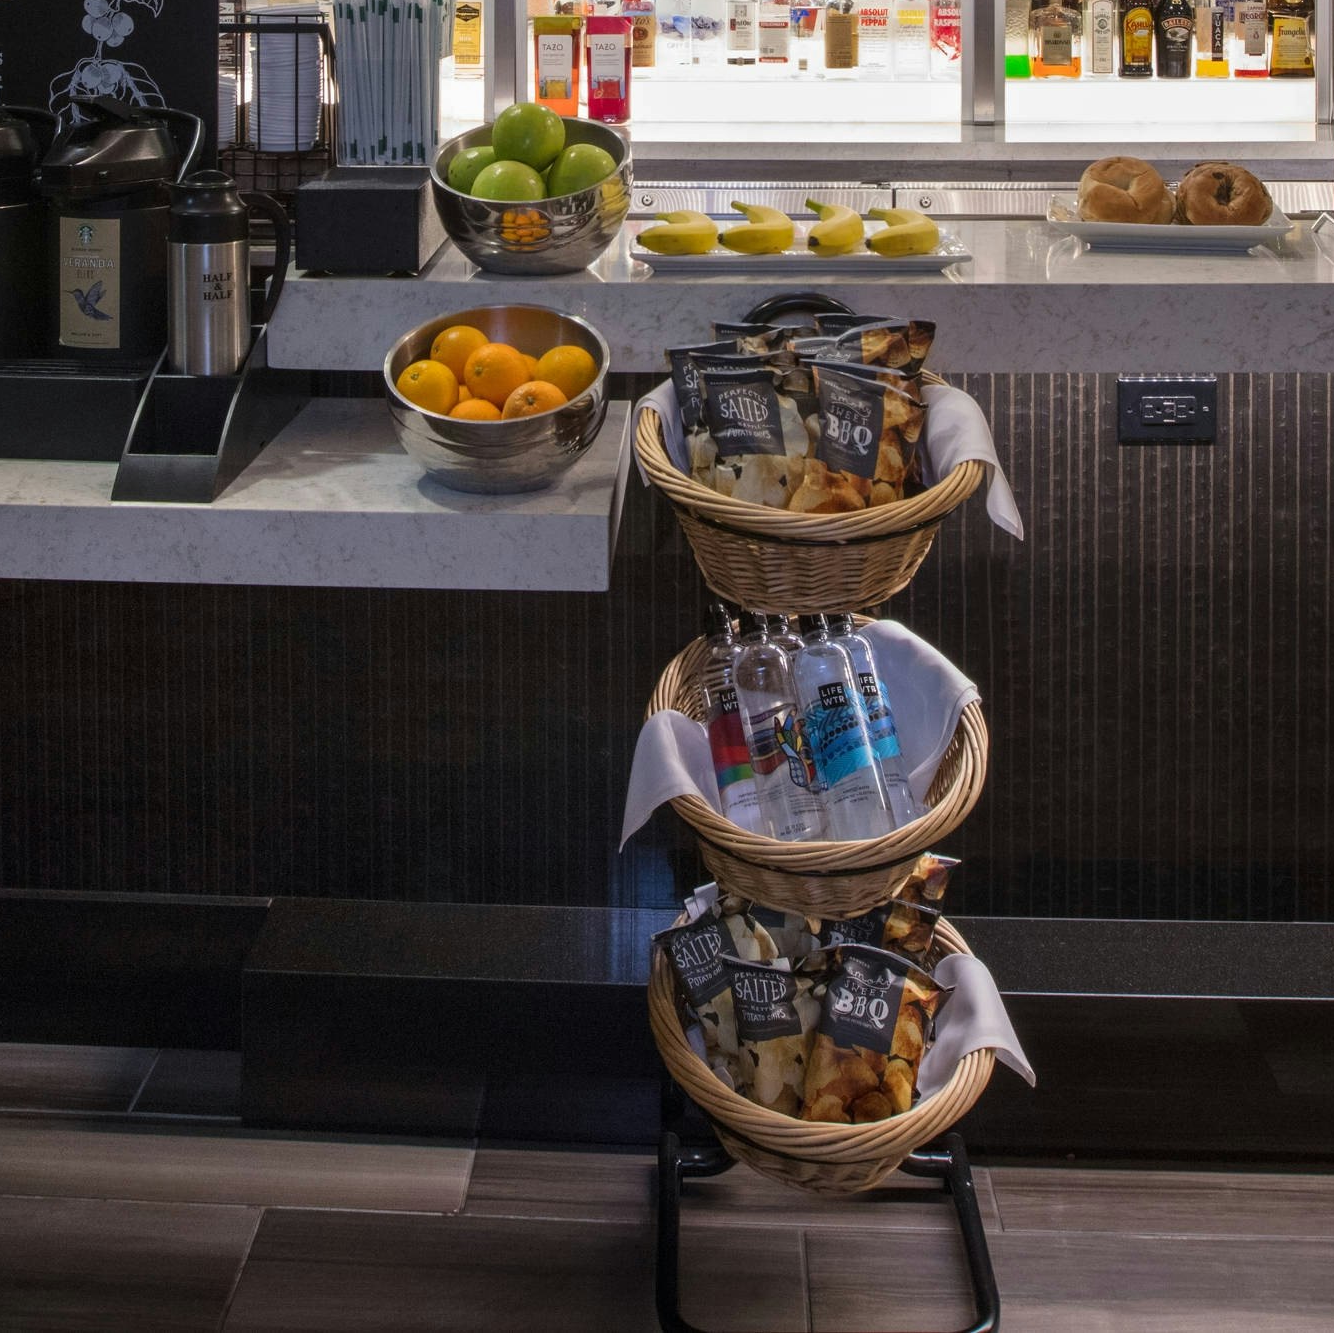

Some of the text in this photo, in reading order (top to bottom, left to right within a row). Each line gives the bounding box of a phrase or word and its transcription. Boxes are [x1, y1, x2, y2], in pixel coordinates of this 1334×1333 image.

[860, 8, 889, 16] ABSOLUT
[861, 19, 887, 27] PEPPAR
[542, 43, 563, 51] TAZO
[595, 43, 616, 51] TAZO
[63, 258, 115, 268] VERANDA
[203, 273, 233, 283] HALF
[214, 283, 222, 291] &
[203, 290, 233, 301] HALF
[718, 388, 768, 405] PERFECTLY
[720, 396, 769, 423] SALTED
[830, 405, 869, 426] SWEET
[825, 411, 873, 456] BBQ
[821, 686, 842, 697] LIFE
[723, 700, 739, 711] WT
[823, 695, 846, 706] WTR
[676, 933, 722, 968] SALTED
[687, 974, 713, 989] POTATO
[735, 978, 787, 1004] SALTED
[845, 980, 888, 998] SWEET
[832, 987, 890, 1029] BBQ
